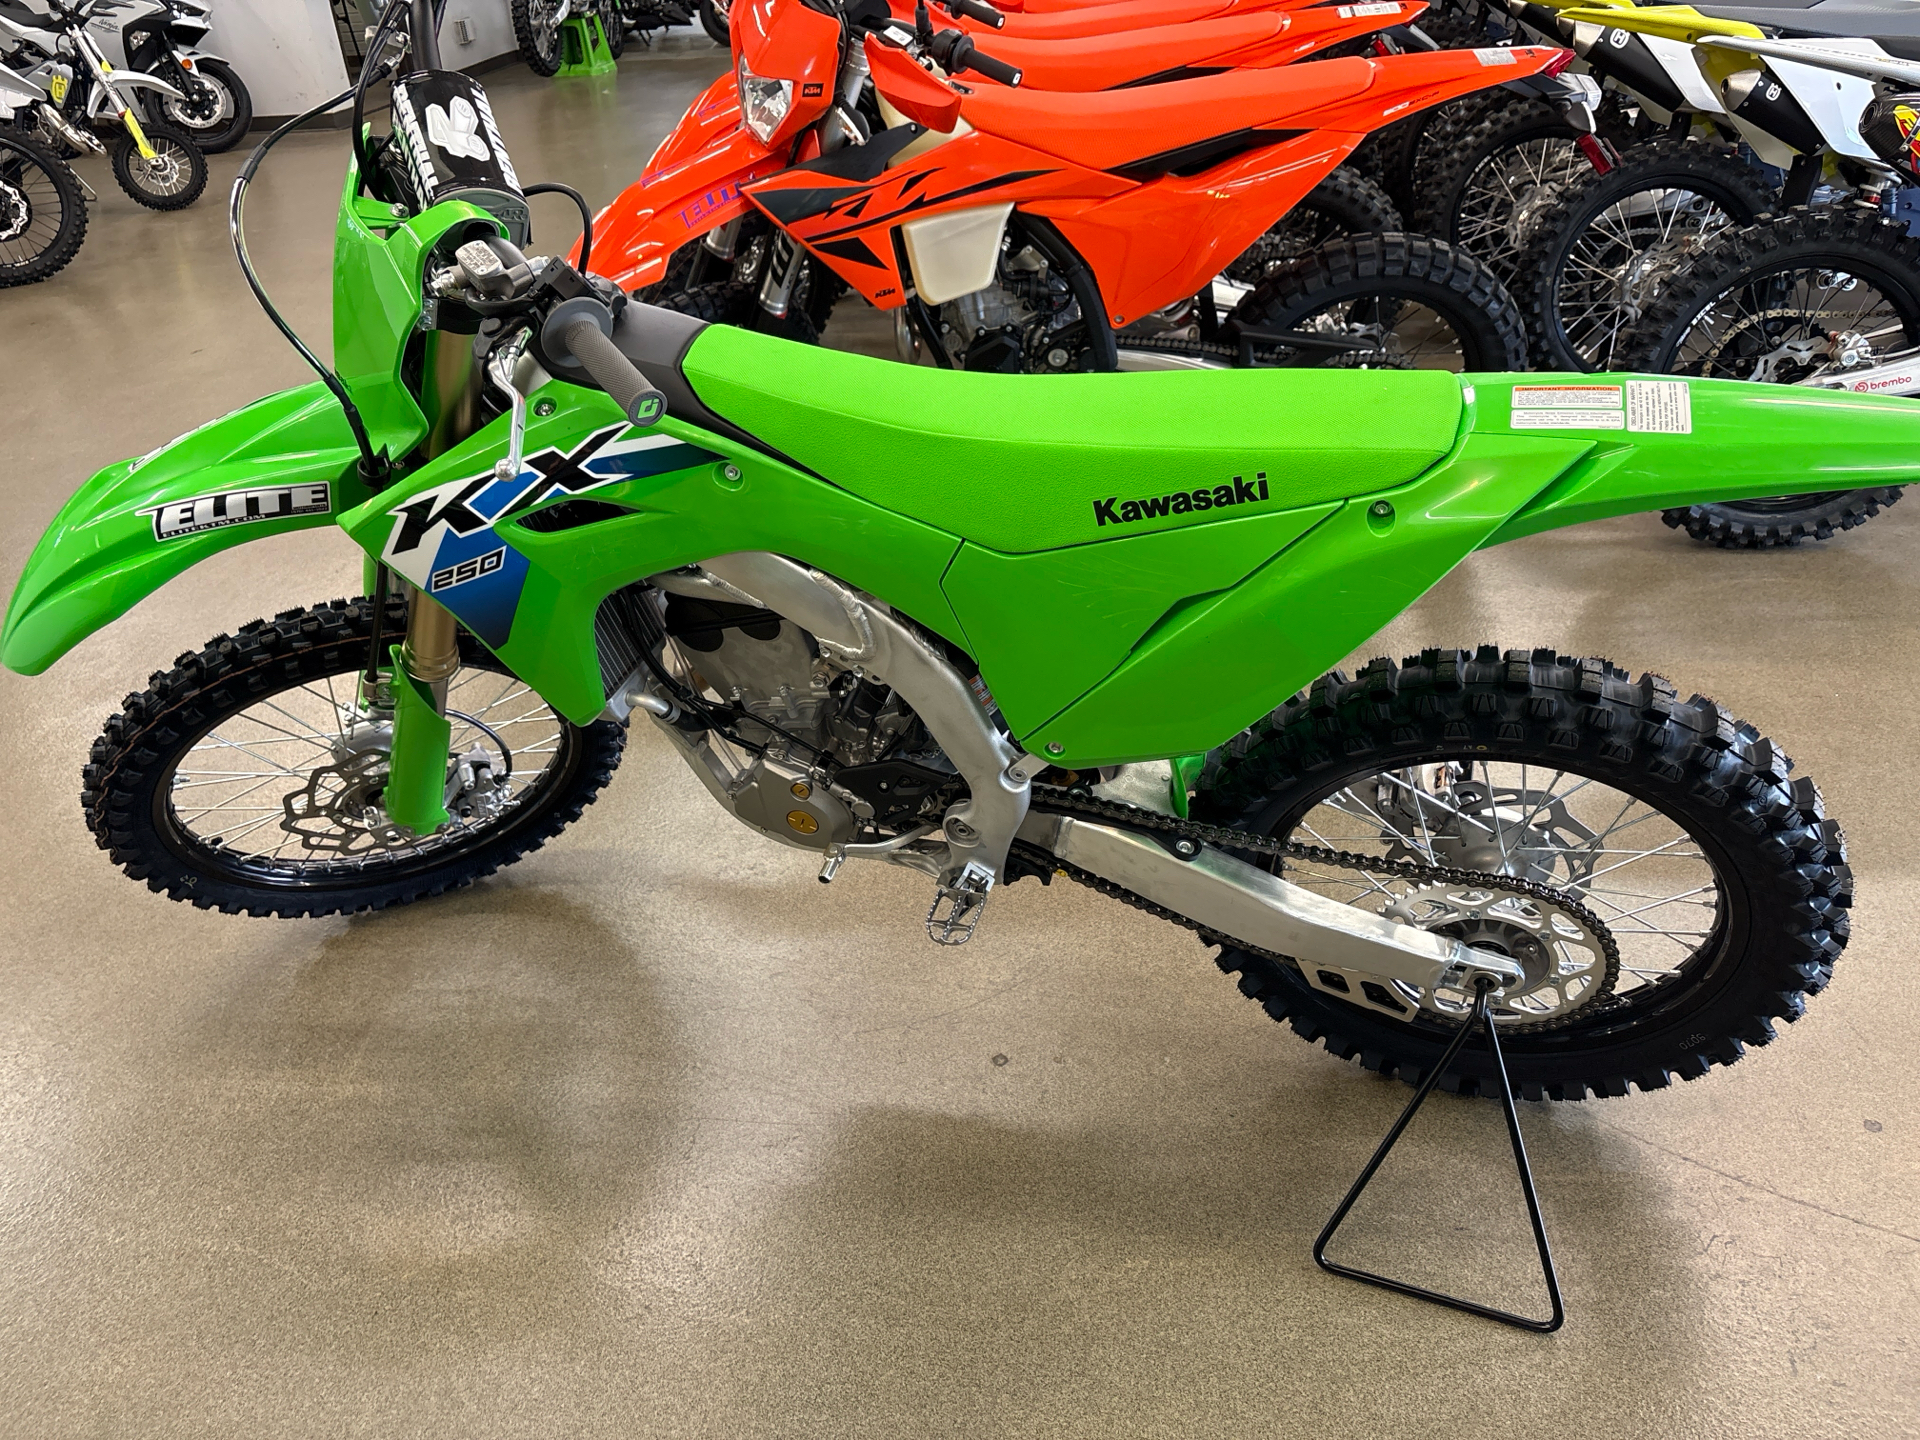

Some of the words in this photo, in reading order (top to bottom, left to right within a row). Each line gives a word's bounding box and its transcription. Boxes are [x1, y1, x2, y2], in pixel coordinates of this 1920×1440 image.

[804, 87, 821, 95] KTM
[470, 87, 525, 197] RENTHAL
[874, 288, 896, 299] KTM
[1869, 375, 1913, 390] brembo
[160, 484, 328, 534] ELITE
[391, 423, 630, 555] KX
[1092, 471, 1270, 527] Kawasaki
[162, 513, 266, 538] ELITEKTM.COM
[433, 548, 505, 591] 250
